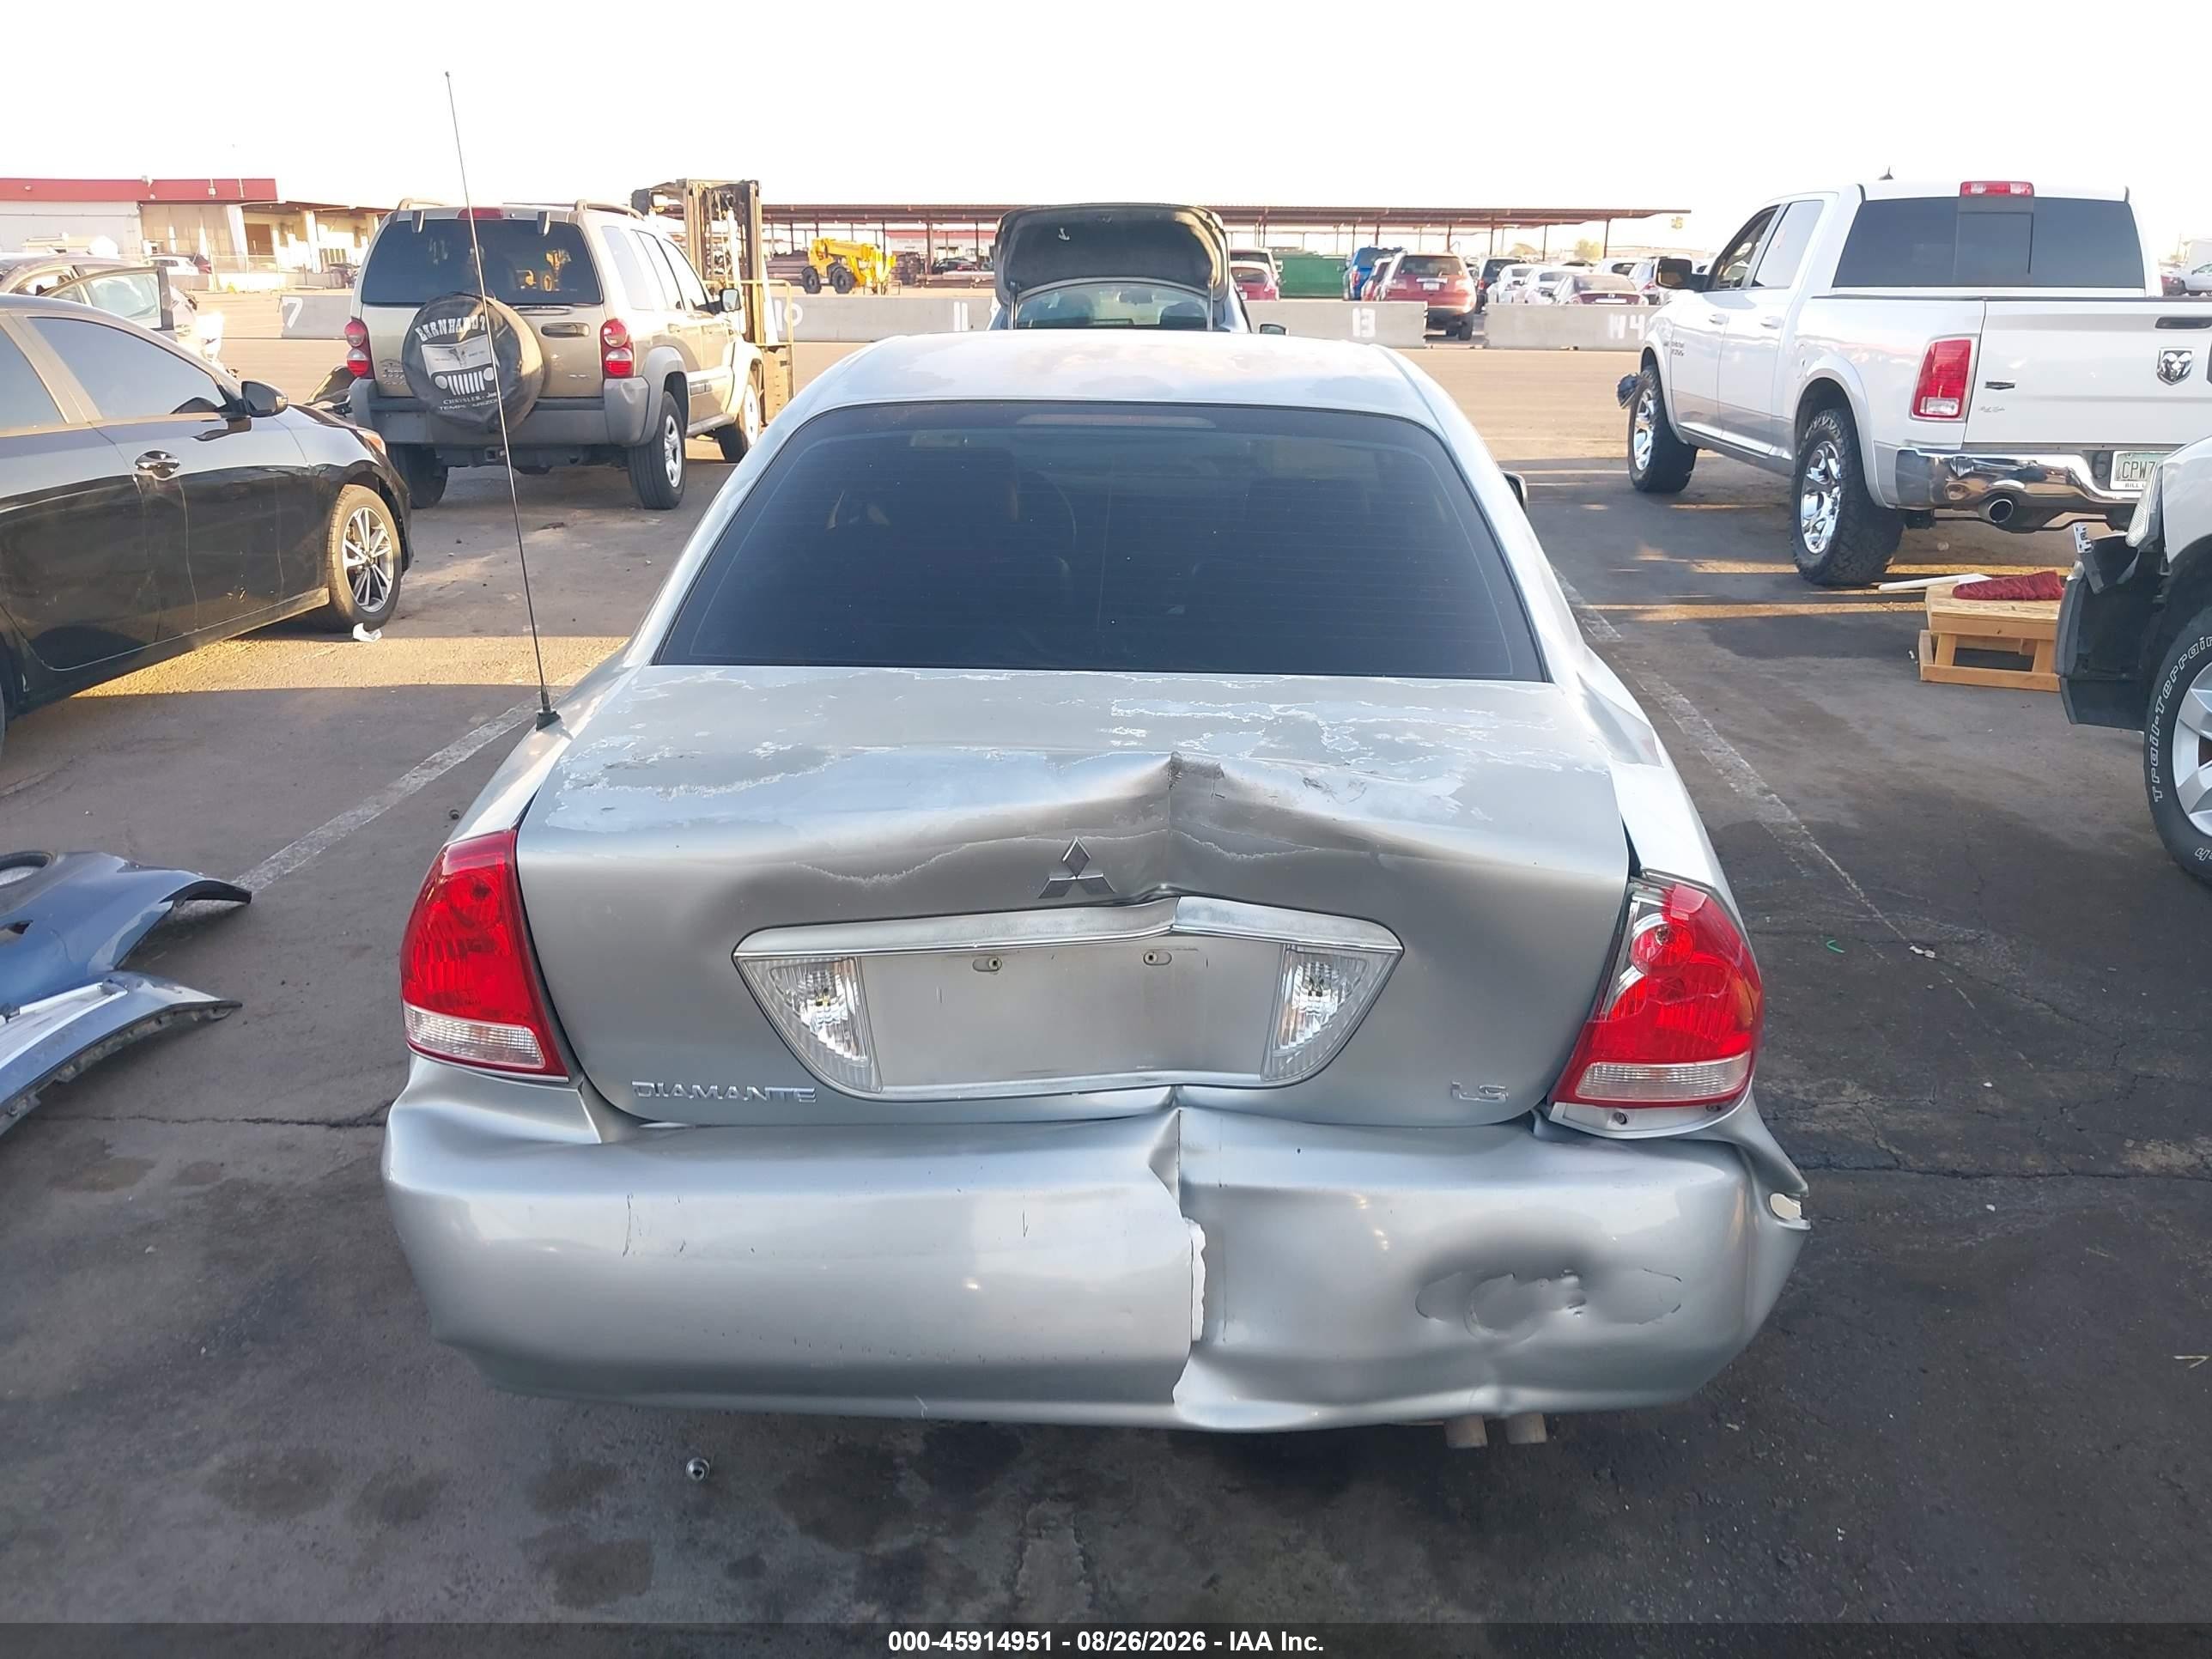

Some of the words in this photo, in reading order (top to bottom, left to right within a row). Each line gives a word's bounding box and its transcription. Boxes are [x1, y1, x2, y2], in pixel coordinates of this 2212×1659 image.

[282, 295, 303, 329] 7
[774, 300, 804, 331] 10
[953, 301, 969, 331] 11
[1352, 308, 1376, 337] 13
[2122, 461, 2156, 479] CPW7
[631, 1080, 817, 1103] DIAMANTE
[1450, 1080, 1509, 1103] LS
